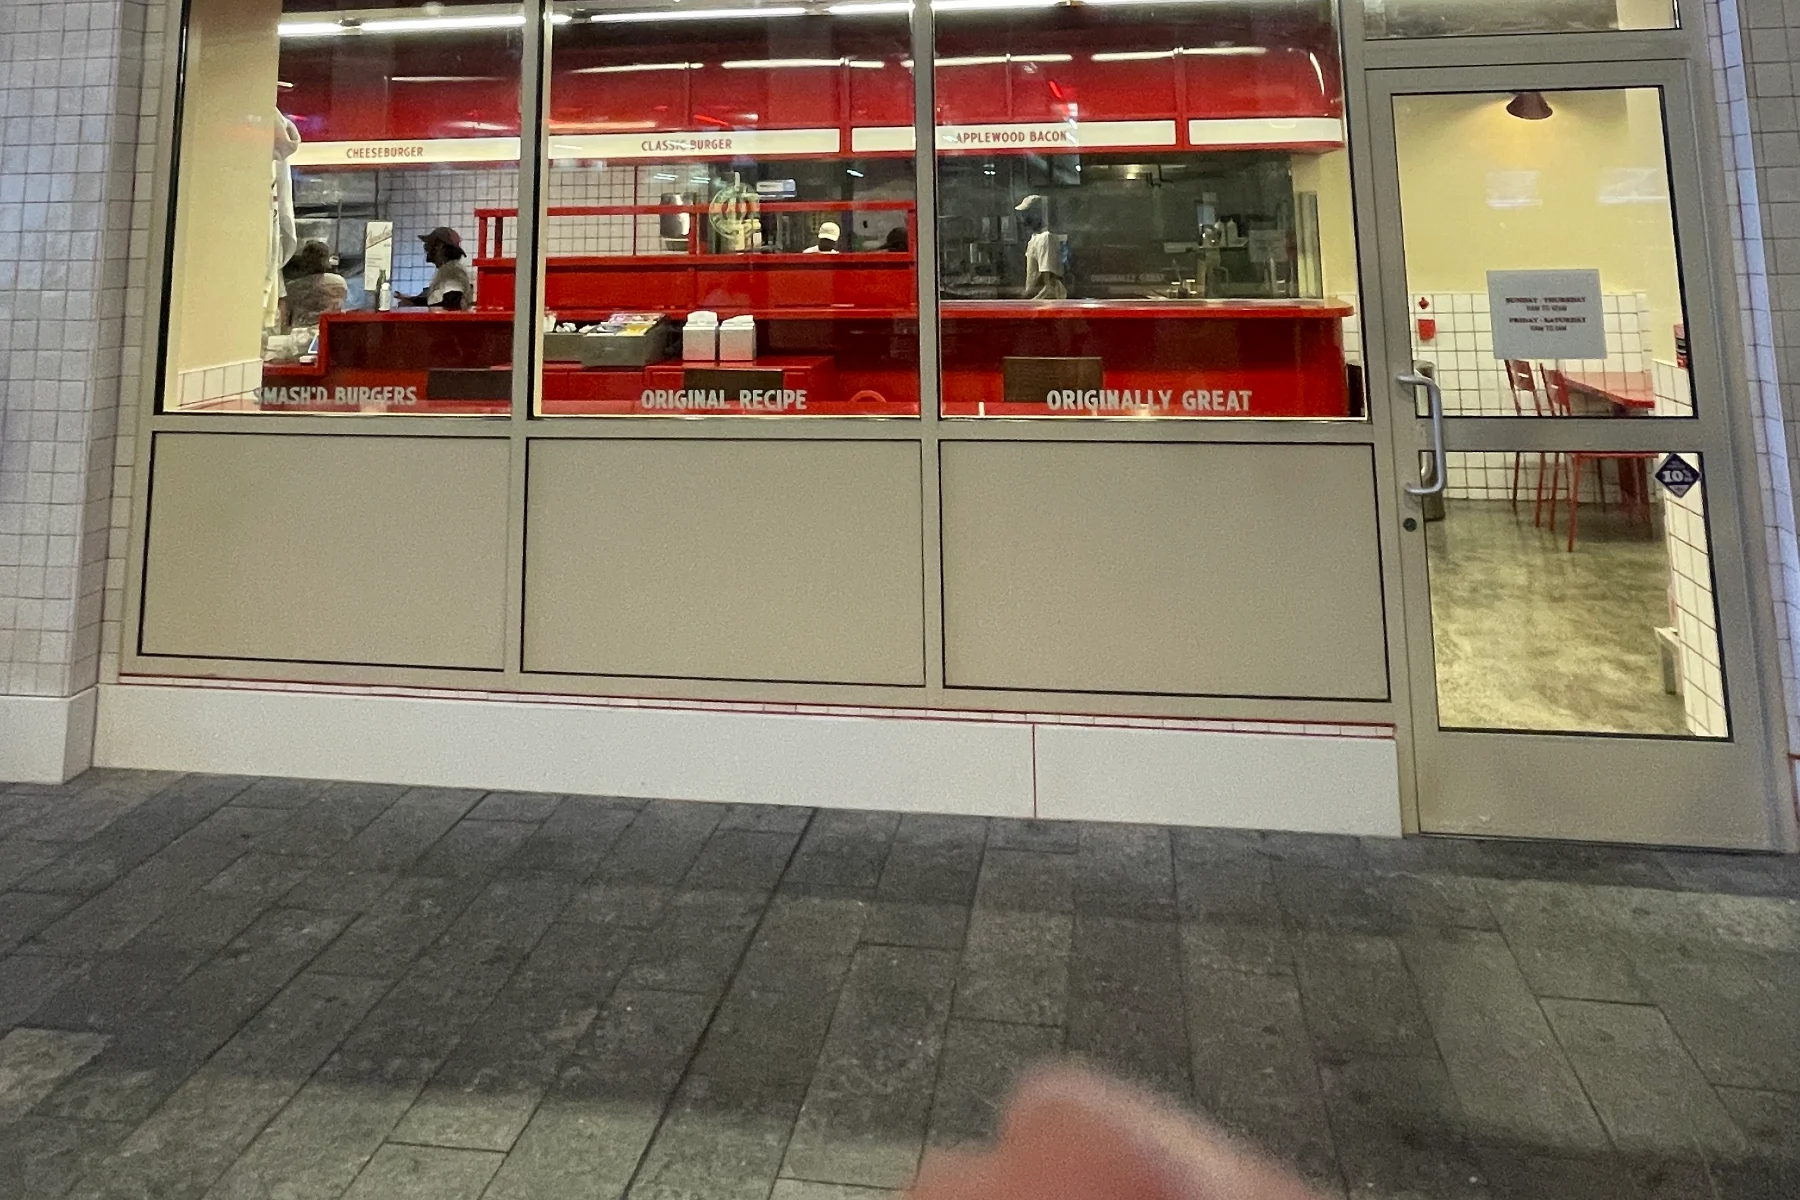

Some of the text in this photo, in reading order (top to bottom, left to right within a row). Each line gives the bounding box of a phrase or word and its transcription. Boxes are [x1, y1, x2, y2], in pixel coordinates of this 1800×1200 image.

[688, 138, 733, 151] BURGER
[955, 130, 1068, 144] APPLEWOOD BACON
[346, 146, 424, 159] CHEESEBURGER
[254, 386, 418, 406] SMASH'D BURGERS
[640, 389, 808, 410] ORIGINAL RECIPE
[1046, 389, 1253, 412] ORIGINALLY GREAT
